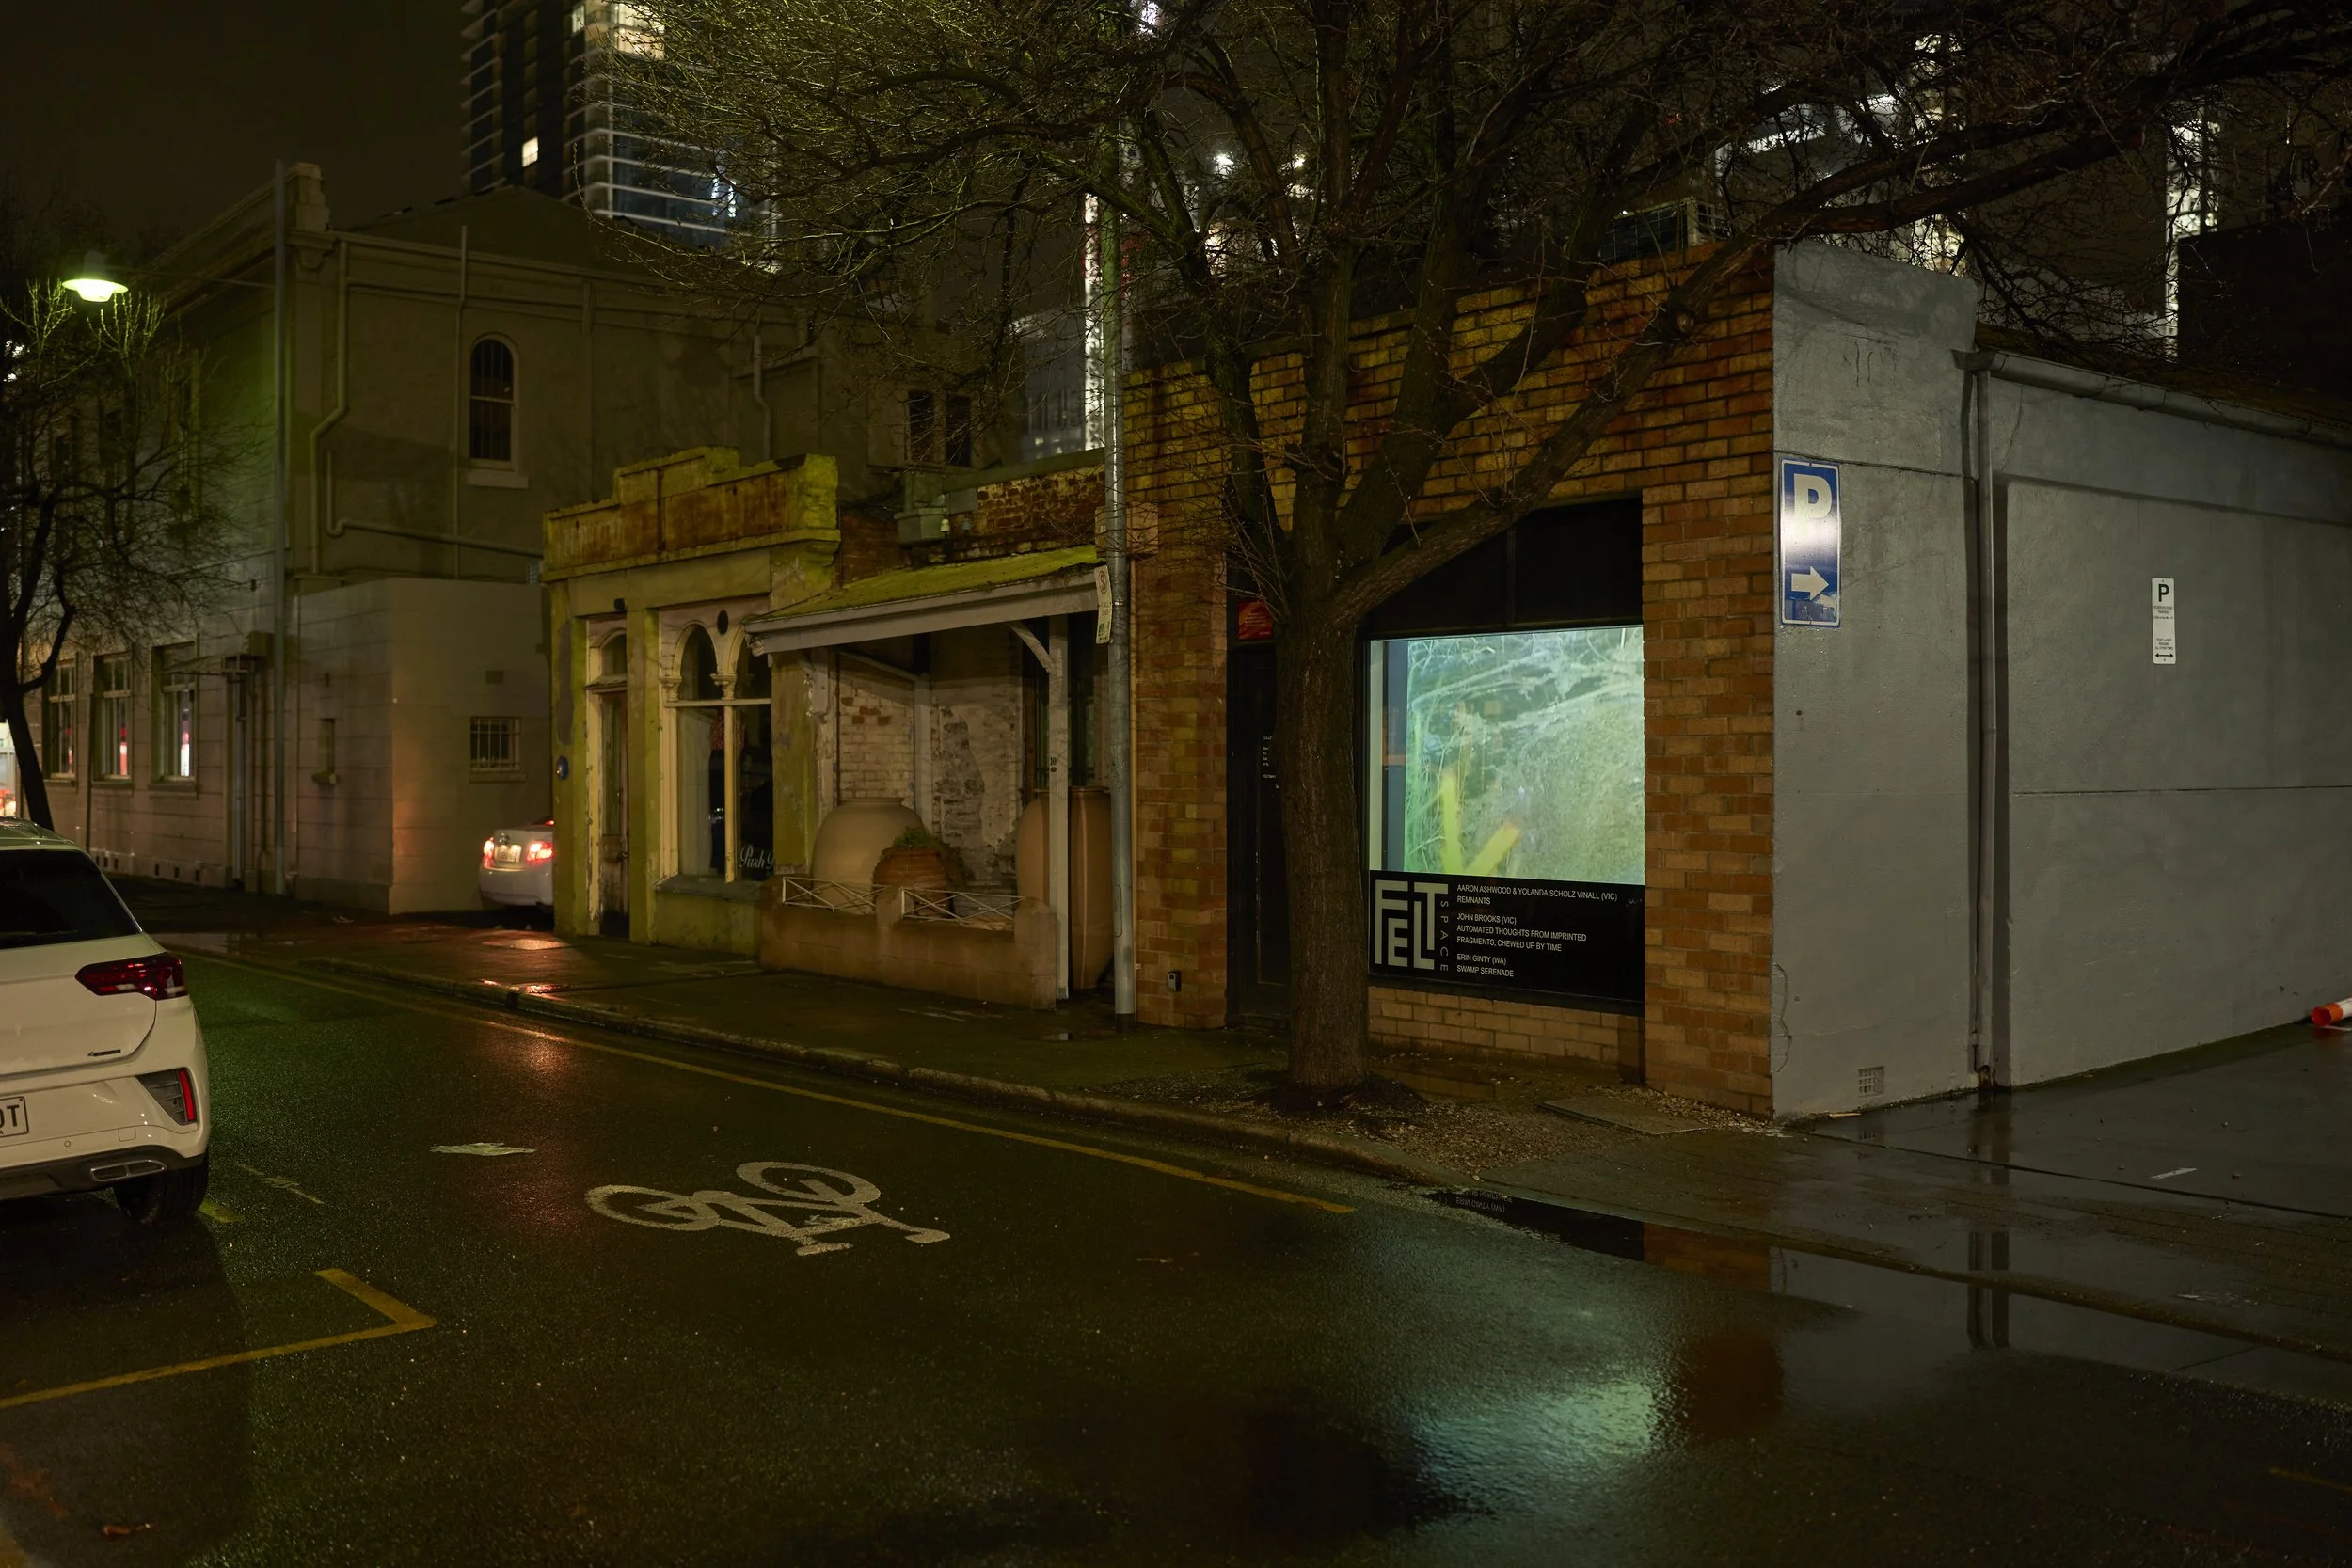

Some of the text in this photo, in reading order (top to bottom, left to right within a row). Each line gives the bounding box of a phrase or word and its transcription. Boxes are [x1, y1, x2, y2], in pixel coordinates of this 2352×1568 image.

[1793, 473, 1833, 539] P
[2158, 583, 2169, 602] P
[738, 843, 766, 869] Push
[1456, 884, 1479, 893] AARON
[1479, 885, 1512, 895] ASHWOOD
[1518, 887, 1549, 896] YOLANDA
[1549, 889, 1576, 898] SCHOLZ
[1576, 891, 1600, 900] VINALL
[1600, 892, 1618, 902] (VIC)
[1456, 895, 1491, 905] REMNANTS
[1375, 879, 1449, 970] FELT
[1456, 912, 1517, 926] JOHN BROOKS (VIC)
[1439, 900, 1449, 972] SPACE
[1456, 925, 1587, 942] AUTOMATED THOUGHTS FROM IMPRINTED
[1456, 936, 1563, 952] FRAGMENTS, CHEWED UP BY TIME
[1456, 953, 1507, 966] ERIN GINTY (WA)
[1456, 965, 1515, 977] SWAMP SERENADE
